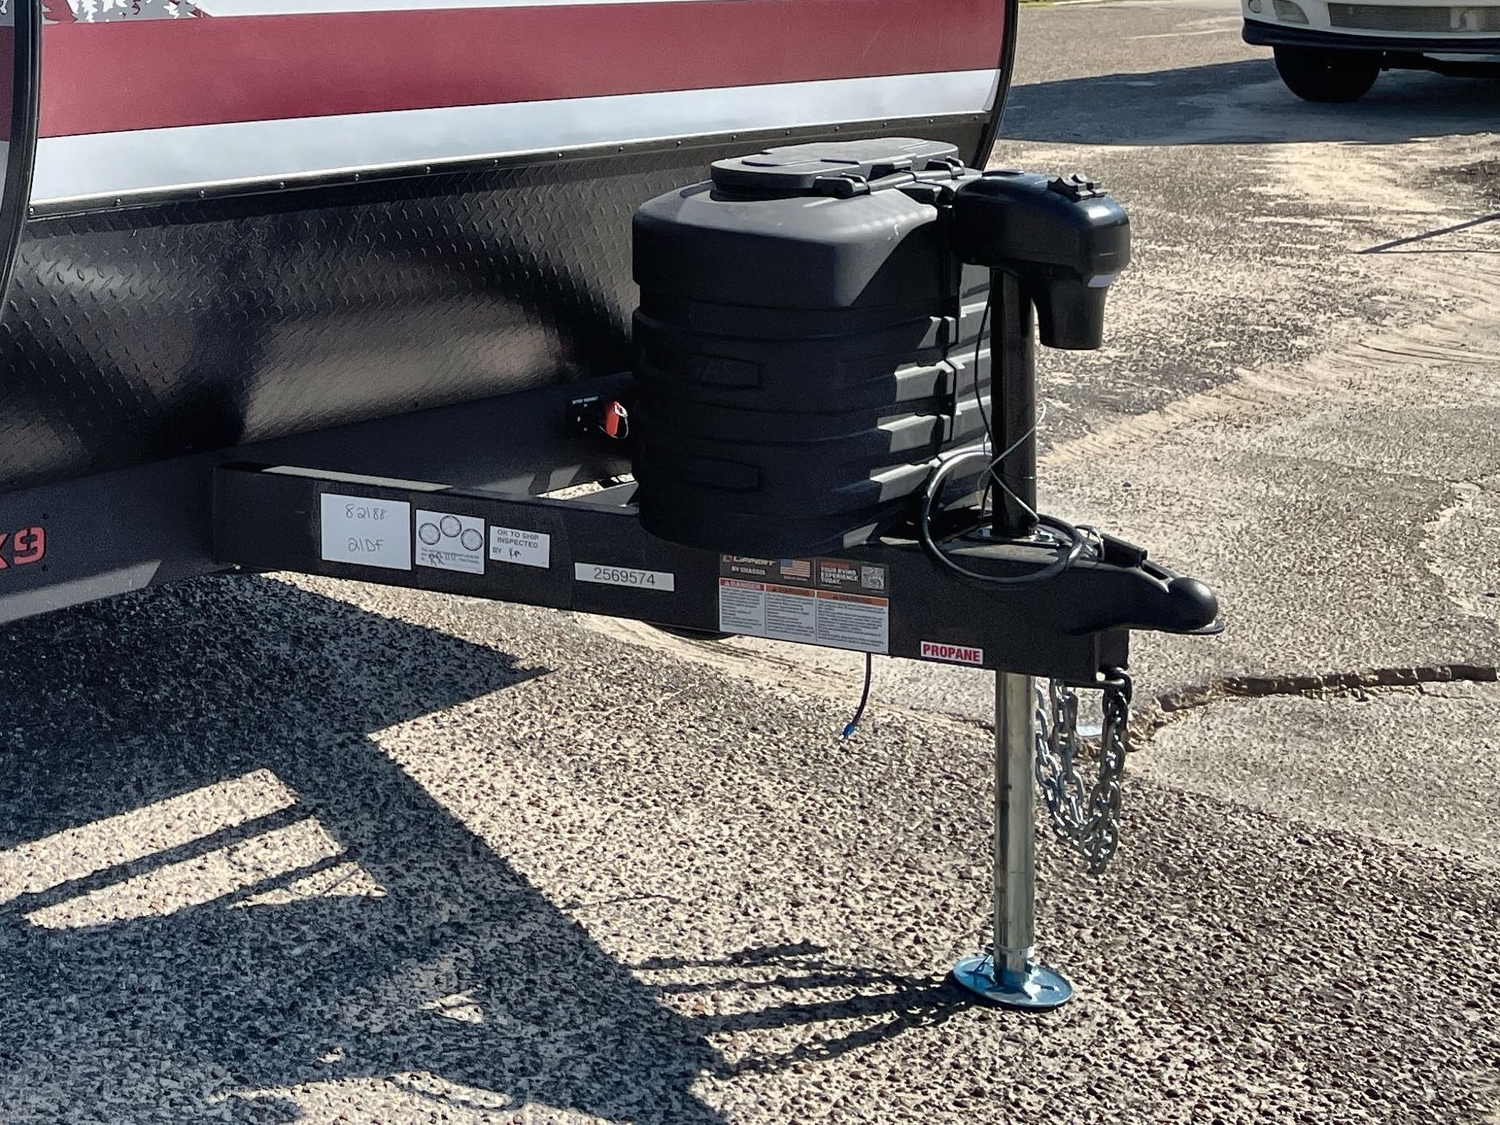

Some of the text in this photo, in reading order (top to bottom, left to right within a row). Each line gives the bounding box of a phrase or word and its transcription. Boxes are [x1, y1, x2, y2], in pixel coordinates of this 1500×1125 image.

[497, 529, 539, 541] OK TO SHIP
[497, 537, 539, 549] INSPECTED
[492, 546, 502, 554] BY
[733, 556, 776, 566] LIPPERT
[593, 567, 656, 586] 2569574
[730, 581, 761, 590] DANGER
[922, 643, 980, 662] PROPANE
